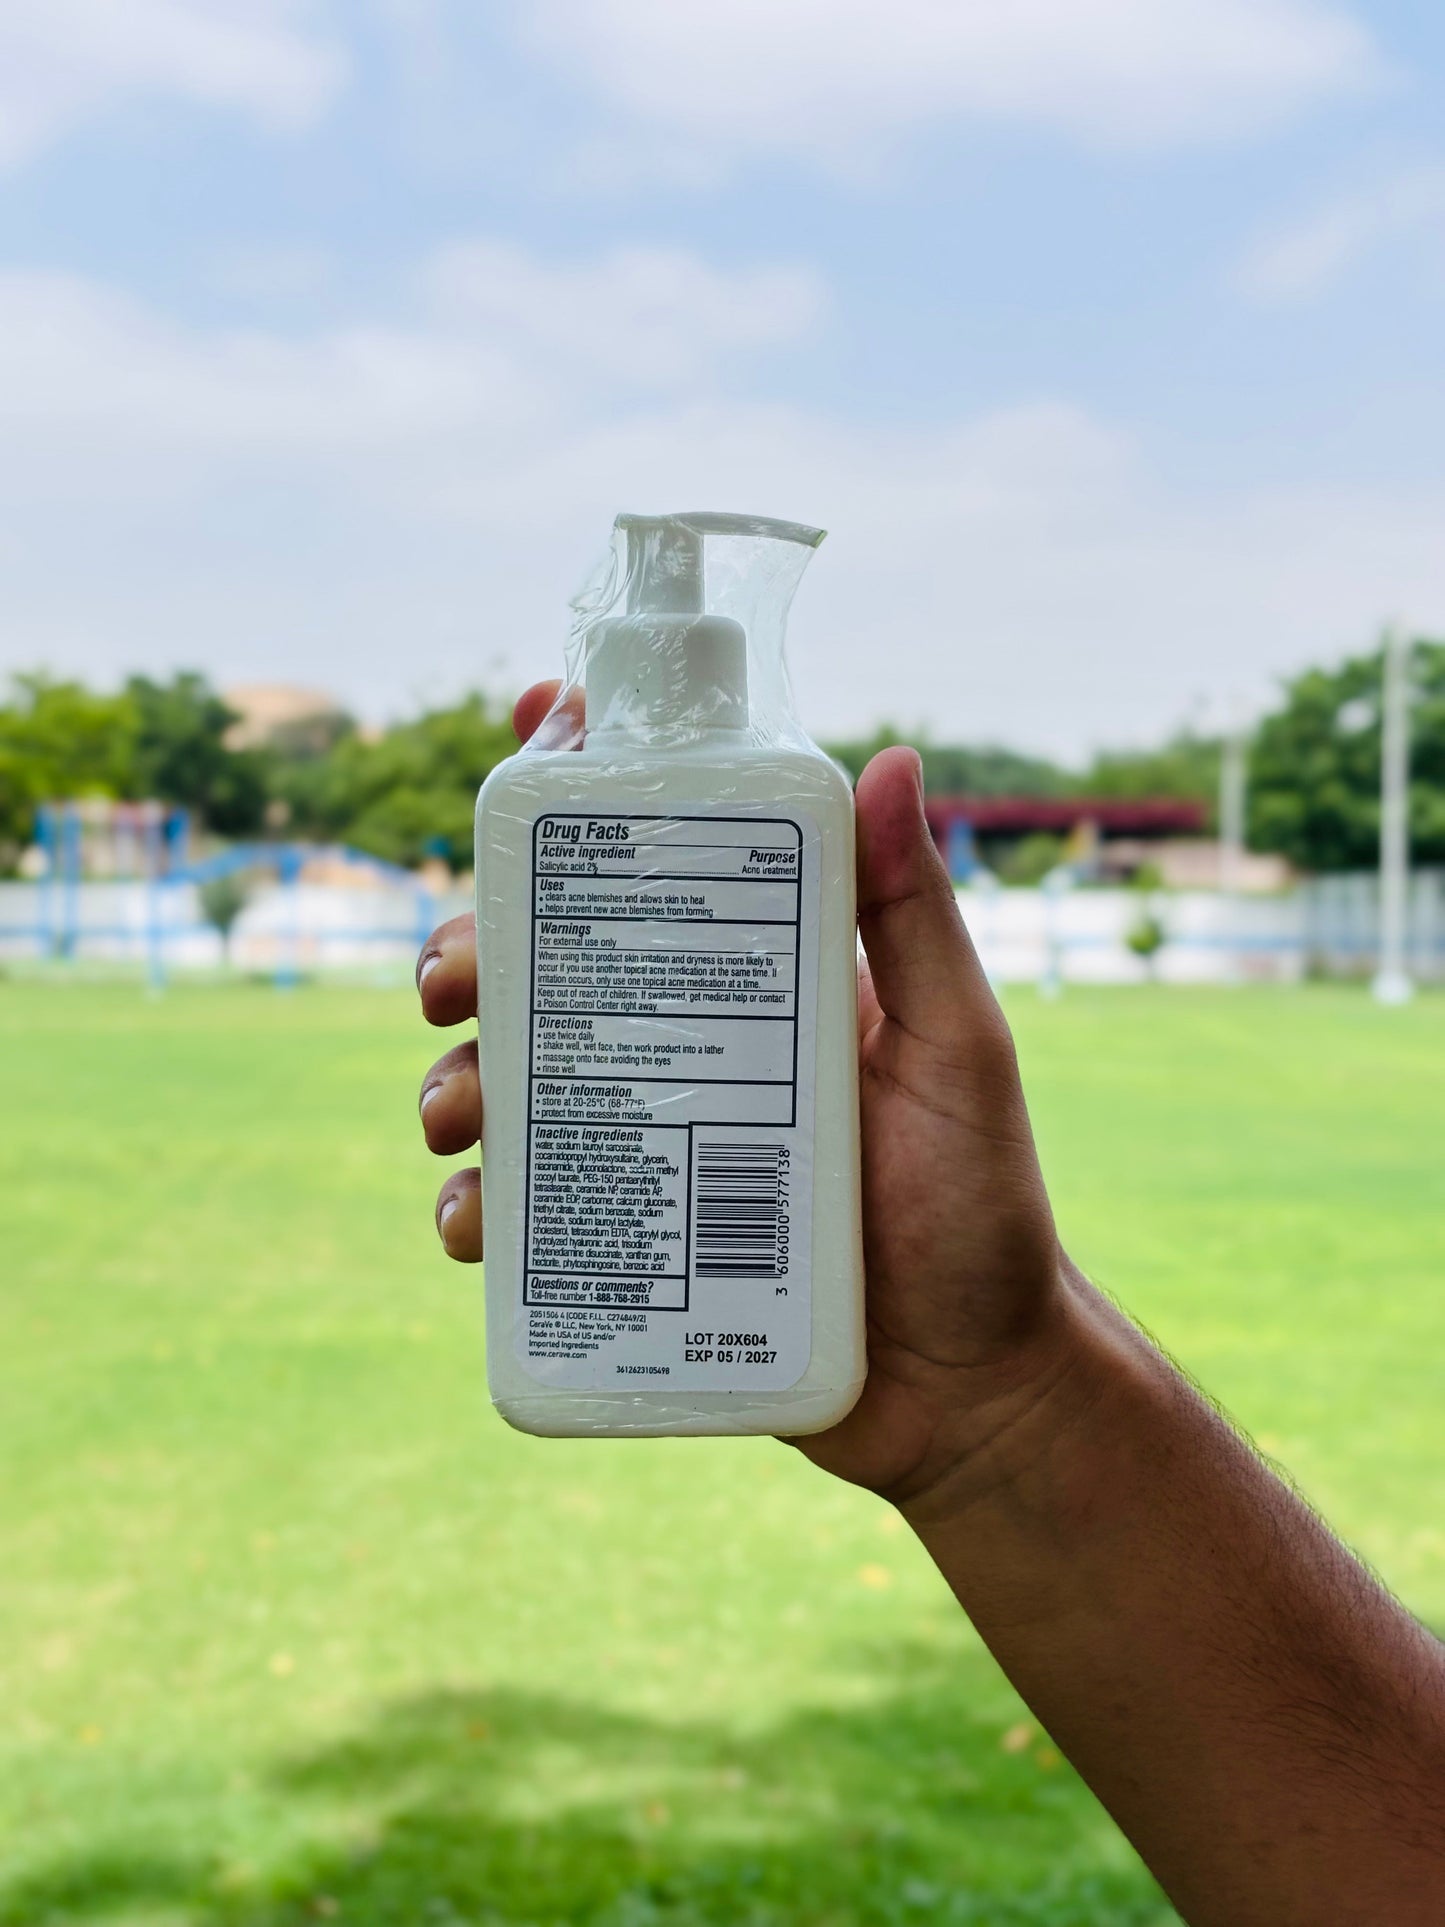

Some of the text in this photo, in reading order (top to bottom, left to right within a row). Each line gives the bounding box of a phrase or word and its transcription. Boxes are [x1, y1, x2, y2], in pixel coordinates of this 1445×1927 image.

[542, 820, 630, 843] Drug Facts
[540, 845, 636, 862] Active ingredient
[749, 849, 796, 866] Purpose
[539, 861, 568, 873] Salicylic
[570, 861, 585, 871] acid
[540, 879, 565, 891] Uses
[545, 892, 705, 905] clears acne blemishes and allows skin to heal
[545, 903, 564, 915] helps
[565, 903, 592, 916] prevent
[593, 906, 608, 914] new
[628, 905, 665, 915] blemishes
[666, 906, 684, 916] from
[685, 906, 714, 919] forming
[540, 922, 592, 938] Warnings
[539, 936, 551, 945] For
[552, 936, 583, 946] external
[600, 937, 617, 949] only
[538, 950, 774, 968] When using this product skin irritation and dryness is more likely to
[538, 964, 558, 972] occur
[559, 963, 564, 972] if
[566, 965, 579, 975] you
[581, 965, 594, 973] use
[595, 963, 622, 974] another
[623, 964, 647, 977] topical
[648, 967, 666, 975] acne
[667, 965, 707, 976] medication
[708, 966, 716, 976] at
[717, 966, 729, 976] the
[730, 969, 750, 977] same
[538, 973, 566, 983] irritation
[567, 976, 594, 986] occurs,
[595, 975, 611, 987] only
[612, 977, 625, 985] use
[642, 976, 666, 988] topical
[686, 977, 726, 987] medication
[727, 978, 735, 988] at
[537, 987, 555, 999] Keep
[556, 988, 568, 997] out
[569, 988, 577, 998] of
[578, 988, 598, 998] reach
[600, 989, 607, 998] of
[641, 990, 646, 999] If
[689, 991, 701, 1003] get
[702, 991, 731, 1002] medical
[732, 992, 748, 1004] help
[758, 993, 786, 1003] contact
[543, 998, 659, 1012] Poison Control Center right away.
[538, 1016, 593, 1029] Directions
[543, 1030, 595, 1043] use twice daily
[543, 1040, 725, 1055] shake well, wet face, then work product into lather
[542, 1053, 671, 1067] massage onto face avoiding the eyes
[542, 1063, 576, 1074] rinse well
[537, 1082, 632, 1097] Other information
[541, 1096, 561, 1106] store
[563, 1097, 571, 1106] at
[541, 1107, 653, 1119] protect from excessive moisture
[535, 1126, 644, 1144] Inactive ingredients
[775, 1149, 791, 1296] 3 606000 577138
[531, 1277, 654, 1292] Questions or comments?
[531, 1290, 650, 1303] Toll-free number 1-888-768-2915
[529, 1320, 648, 1332] CeraVe LLC, New York, NY 10001
[529, 1330, 616, 1342] Made in USA of US and/or
[685, 1333, 768, 1346] LOT 20X604
[529, 1340, 599, 1352] Imported Ingredients
[685, 1350, 777, 1363] EXP 05 / 2027
[616, 1365, 670, 1374] 3612623105498
